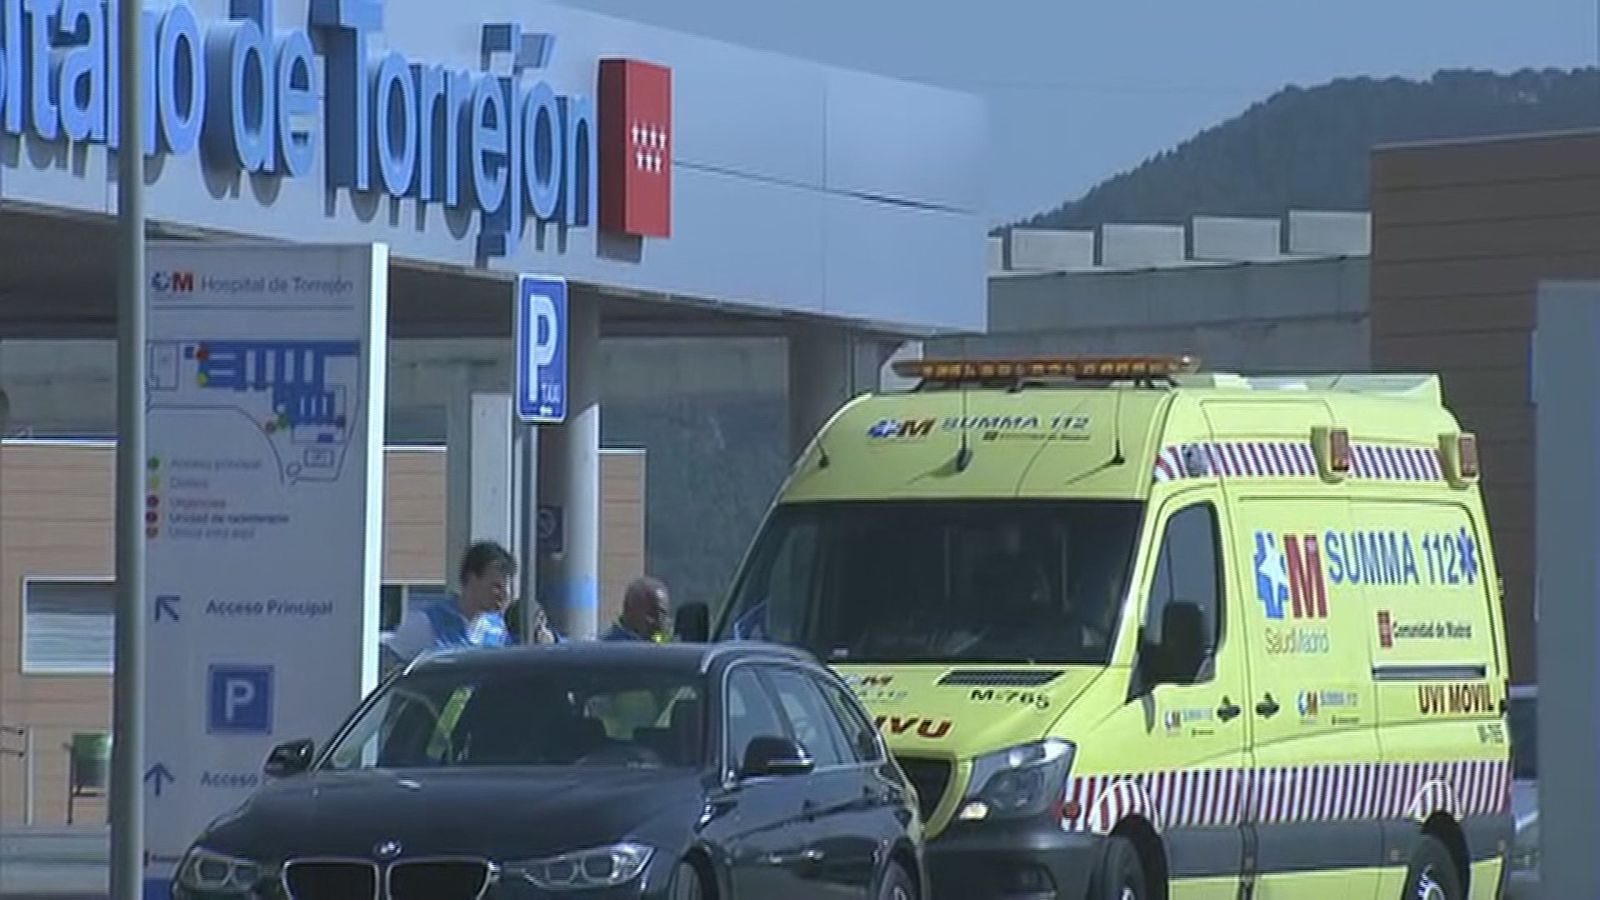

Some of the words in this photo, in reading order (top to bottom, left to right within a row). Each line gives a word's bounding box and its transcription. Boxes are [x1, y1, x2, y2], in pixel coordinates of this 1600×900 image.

[230, 0, 319, 177] de
[341, 0, 598, 257] Torrejón
[202, 275, 265, 296] Hospital
[268, 276, 288, 293] de
[293, 276, 354, 297] Torrejón
[528, 294, 558, 403] P
[1052, 416, 1090, 428] 112
[1325, 530, 1419, 584] SUMMA
[1423, 532, 1459, 584] 112
[205, 599, 263, 615] Acceso
[268, 599, 334, 617] Principal
[226, 680, 255, 721] P
[1418, 685, 1445, 715] UVI
[1448, 684, 1495, 713] MOVIL
[200, 770, 259, 787] Acceso
